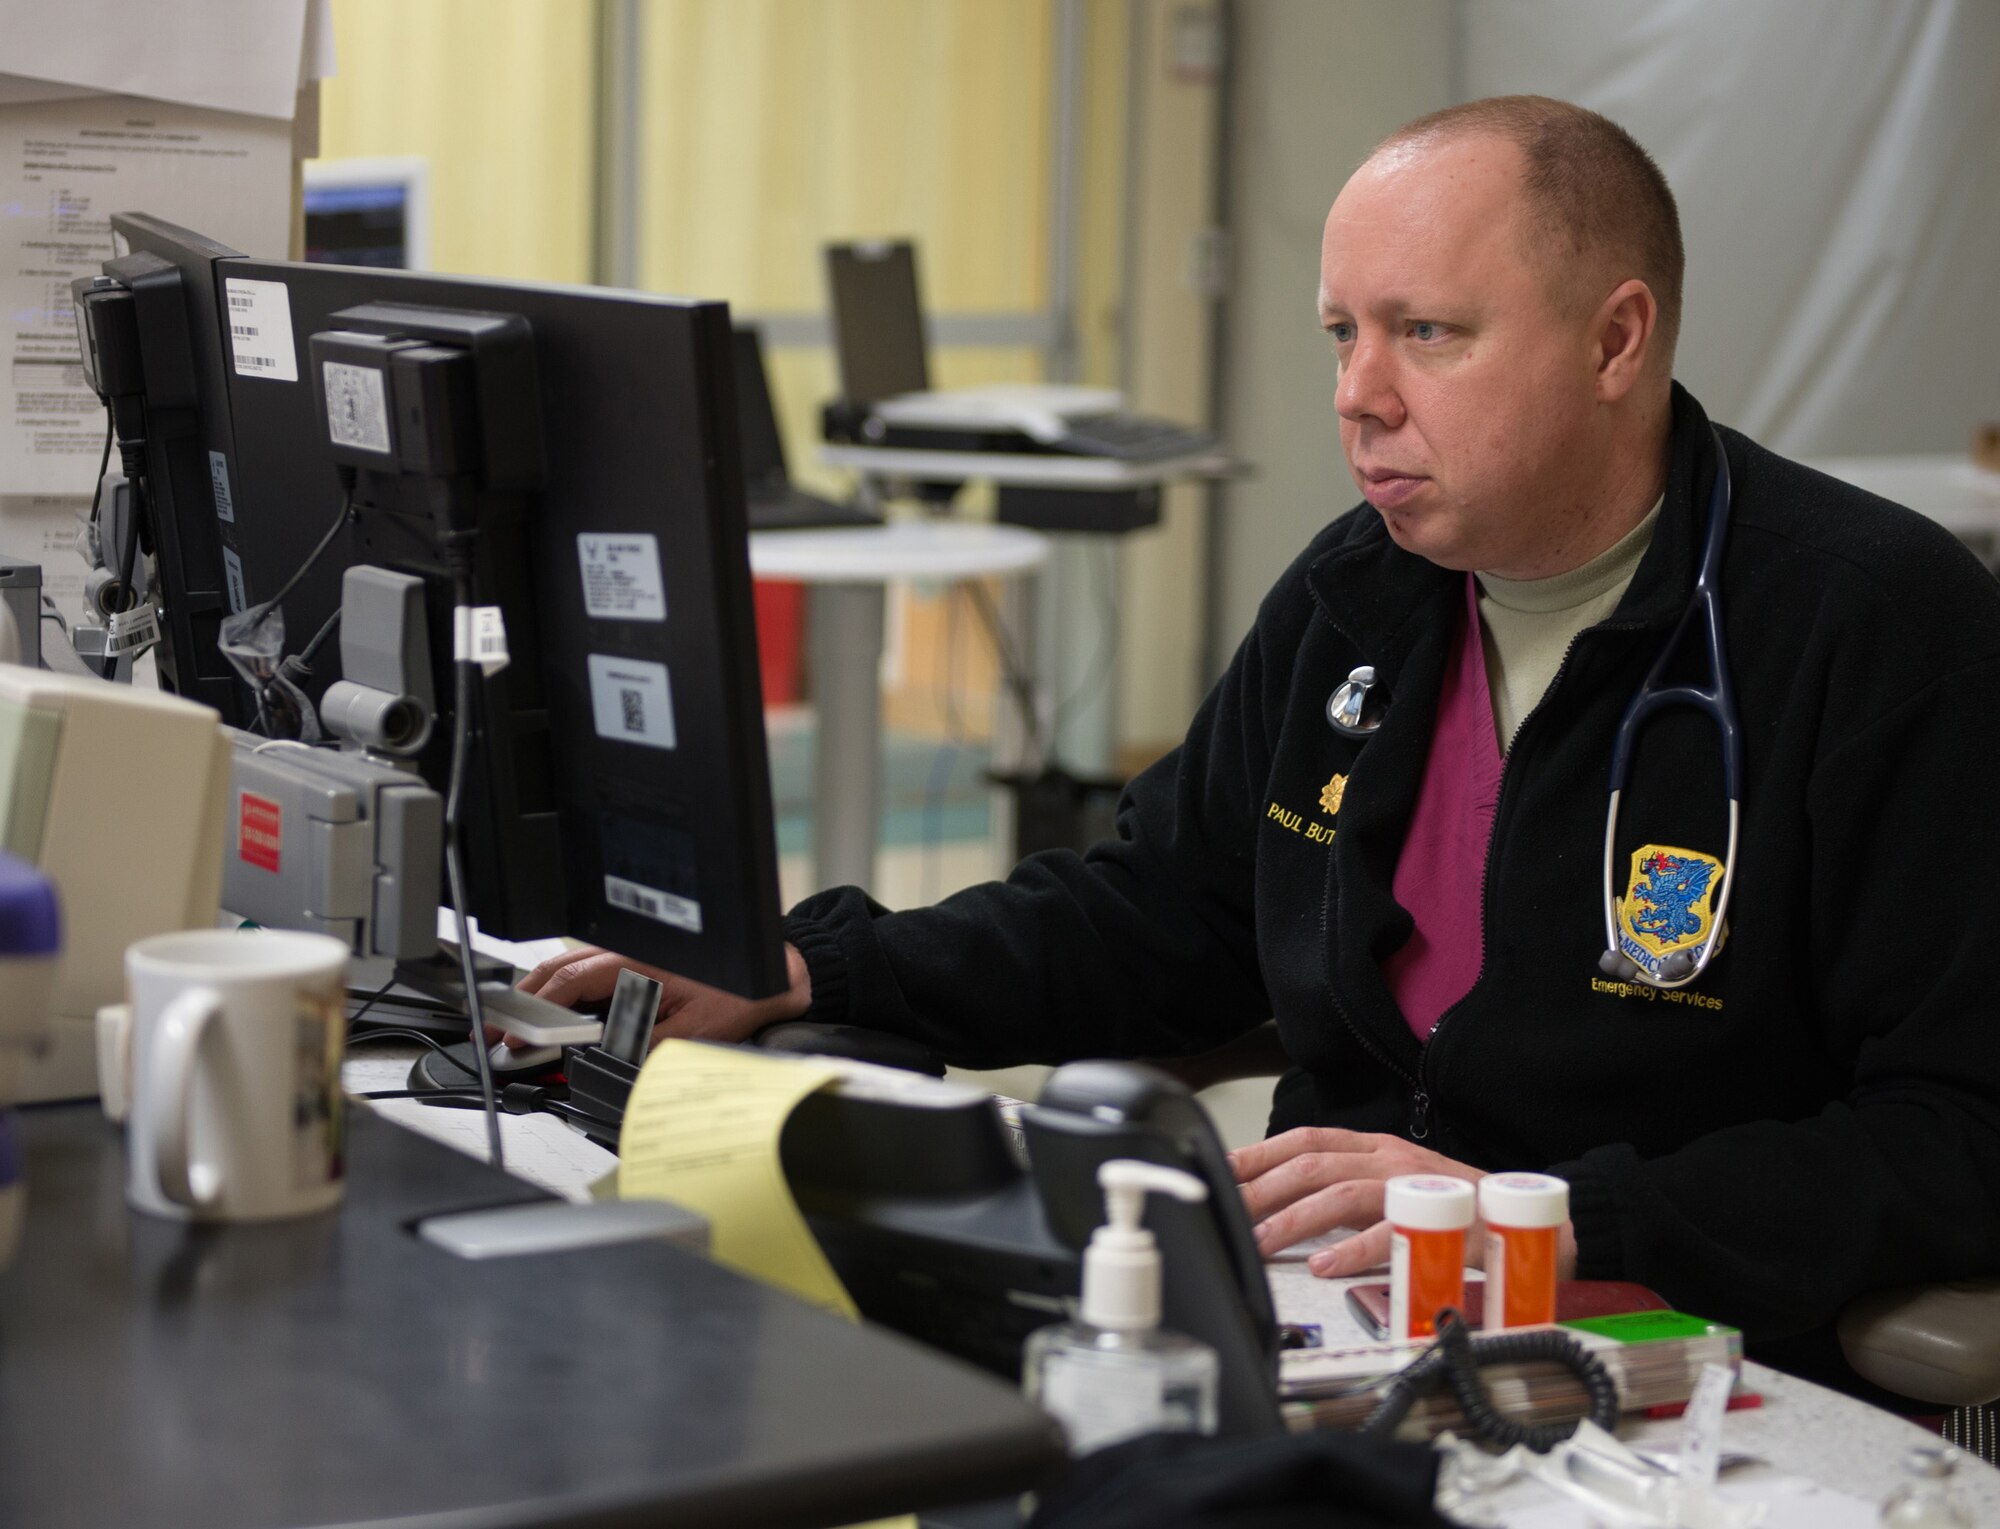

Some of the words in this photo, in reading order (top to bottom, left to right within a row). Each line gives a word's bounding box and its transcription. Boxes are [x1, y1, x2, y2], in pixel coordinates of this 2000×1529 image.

[1267, 802, 1302, 832] PAUL
[1621, 936, 1666, 973] MEDIC
[1591, 977, 1656, 1000] Emergency
[1661, 990, 1723, 1010] Services
